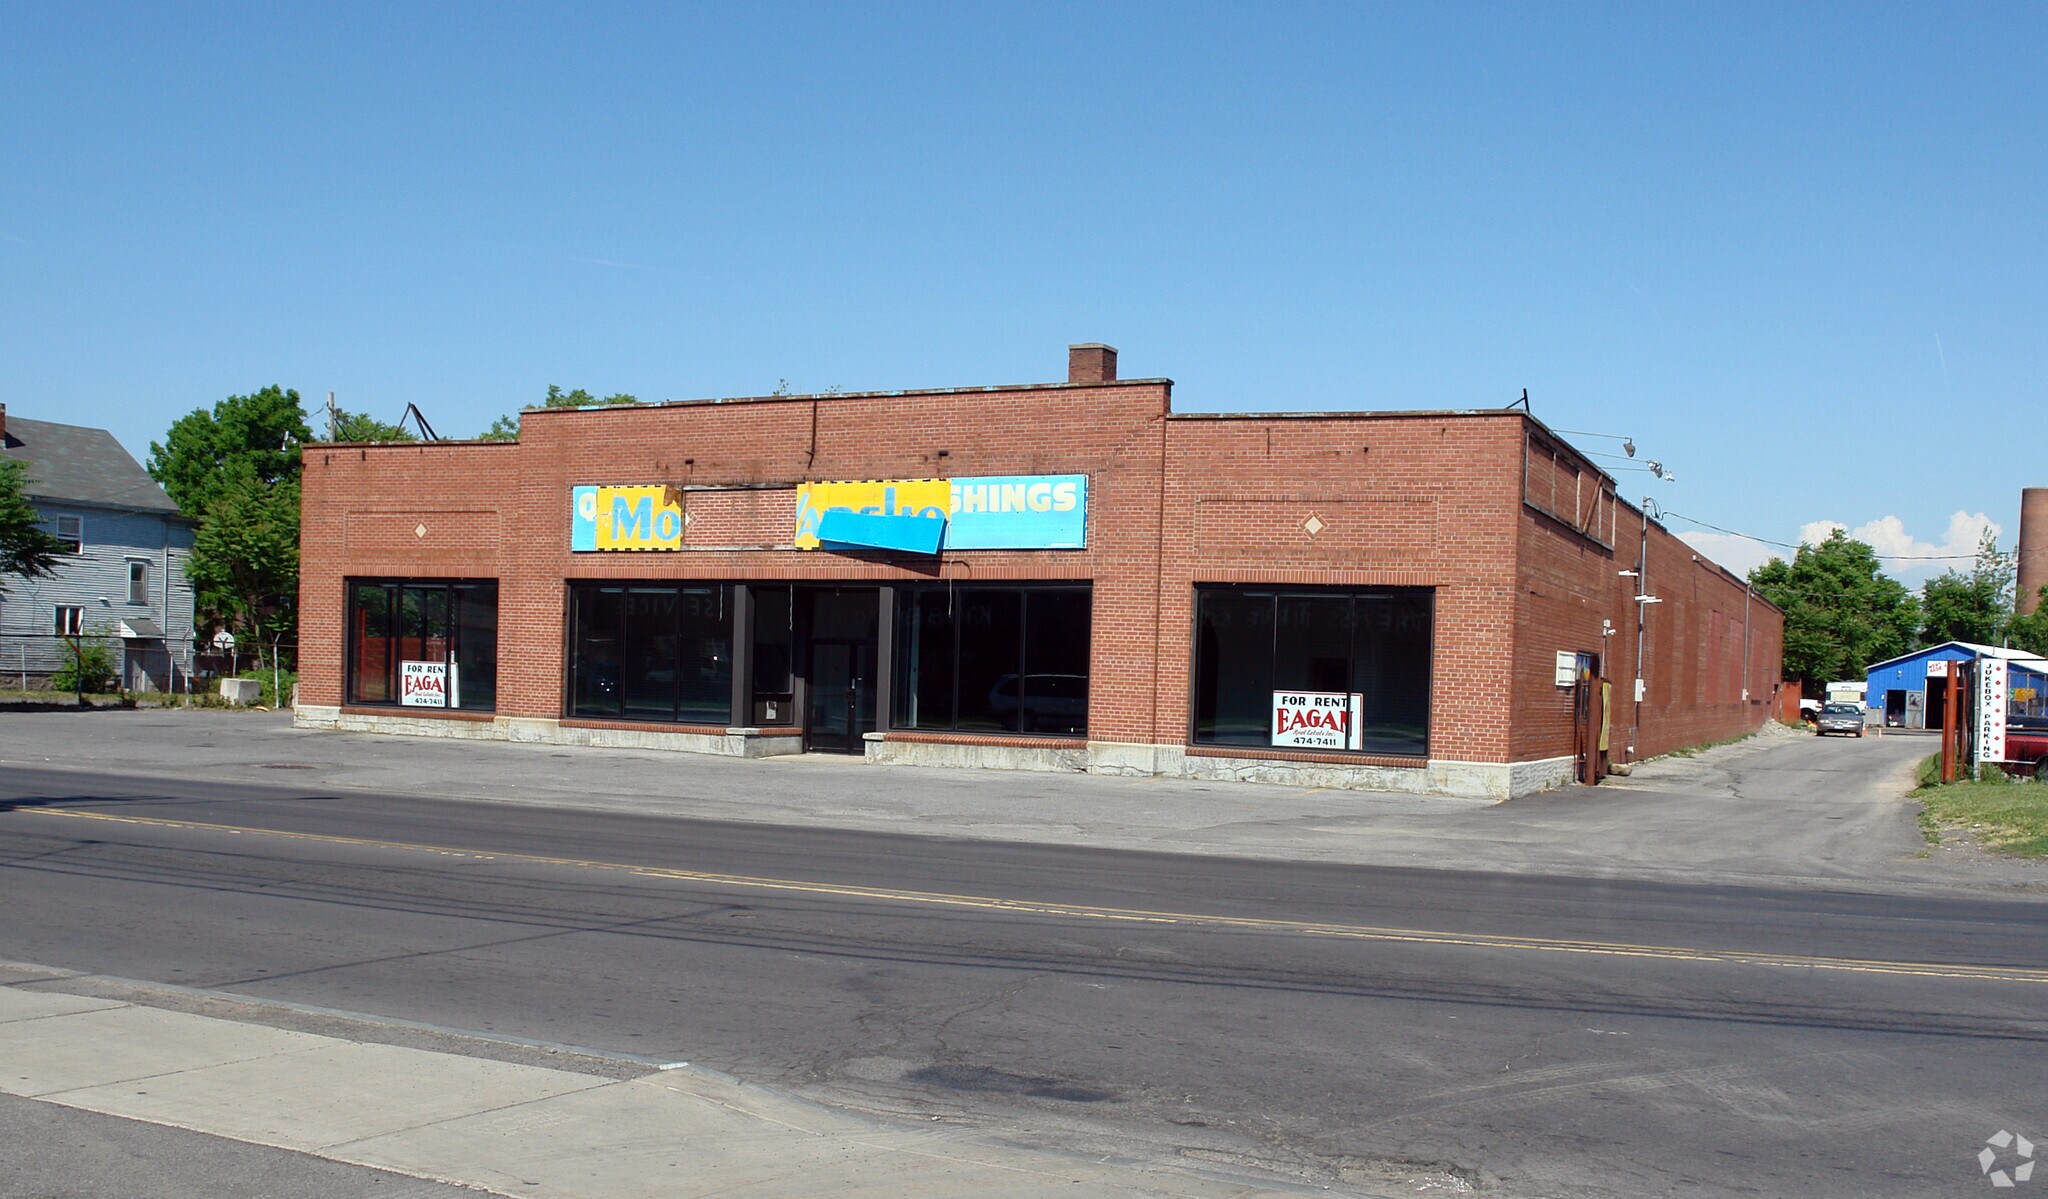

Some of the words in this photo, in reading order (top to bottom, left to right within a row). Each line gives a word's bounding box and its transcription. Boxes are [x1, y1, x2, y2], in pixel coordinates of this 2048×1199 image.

[1984, 663, 1992, 707] JUKEBOX
[1282, 696, 1306, 706] FOR
[1315, 697, 1347, 707] RENT
[1277, 708, 1353, 737] EAGAN
[1983, 714, 1991, 758] PARKING
[1293, 737, 1336, 745] 474-7411
